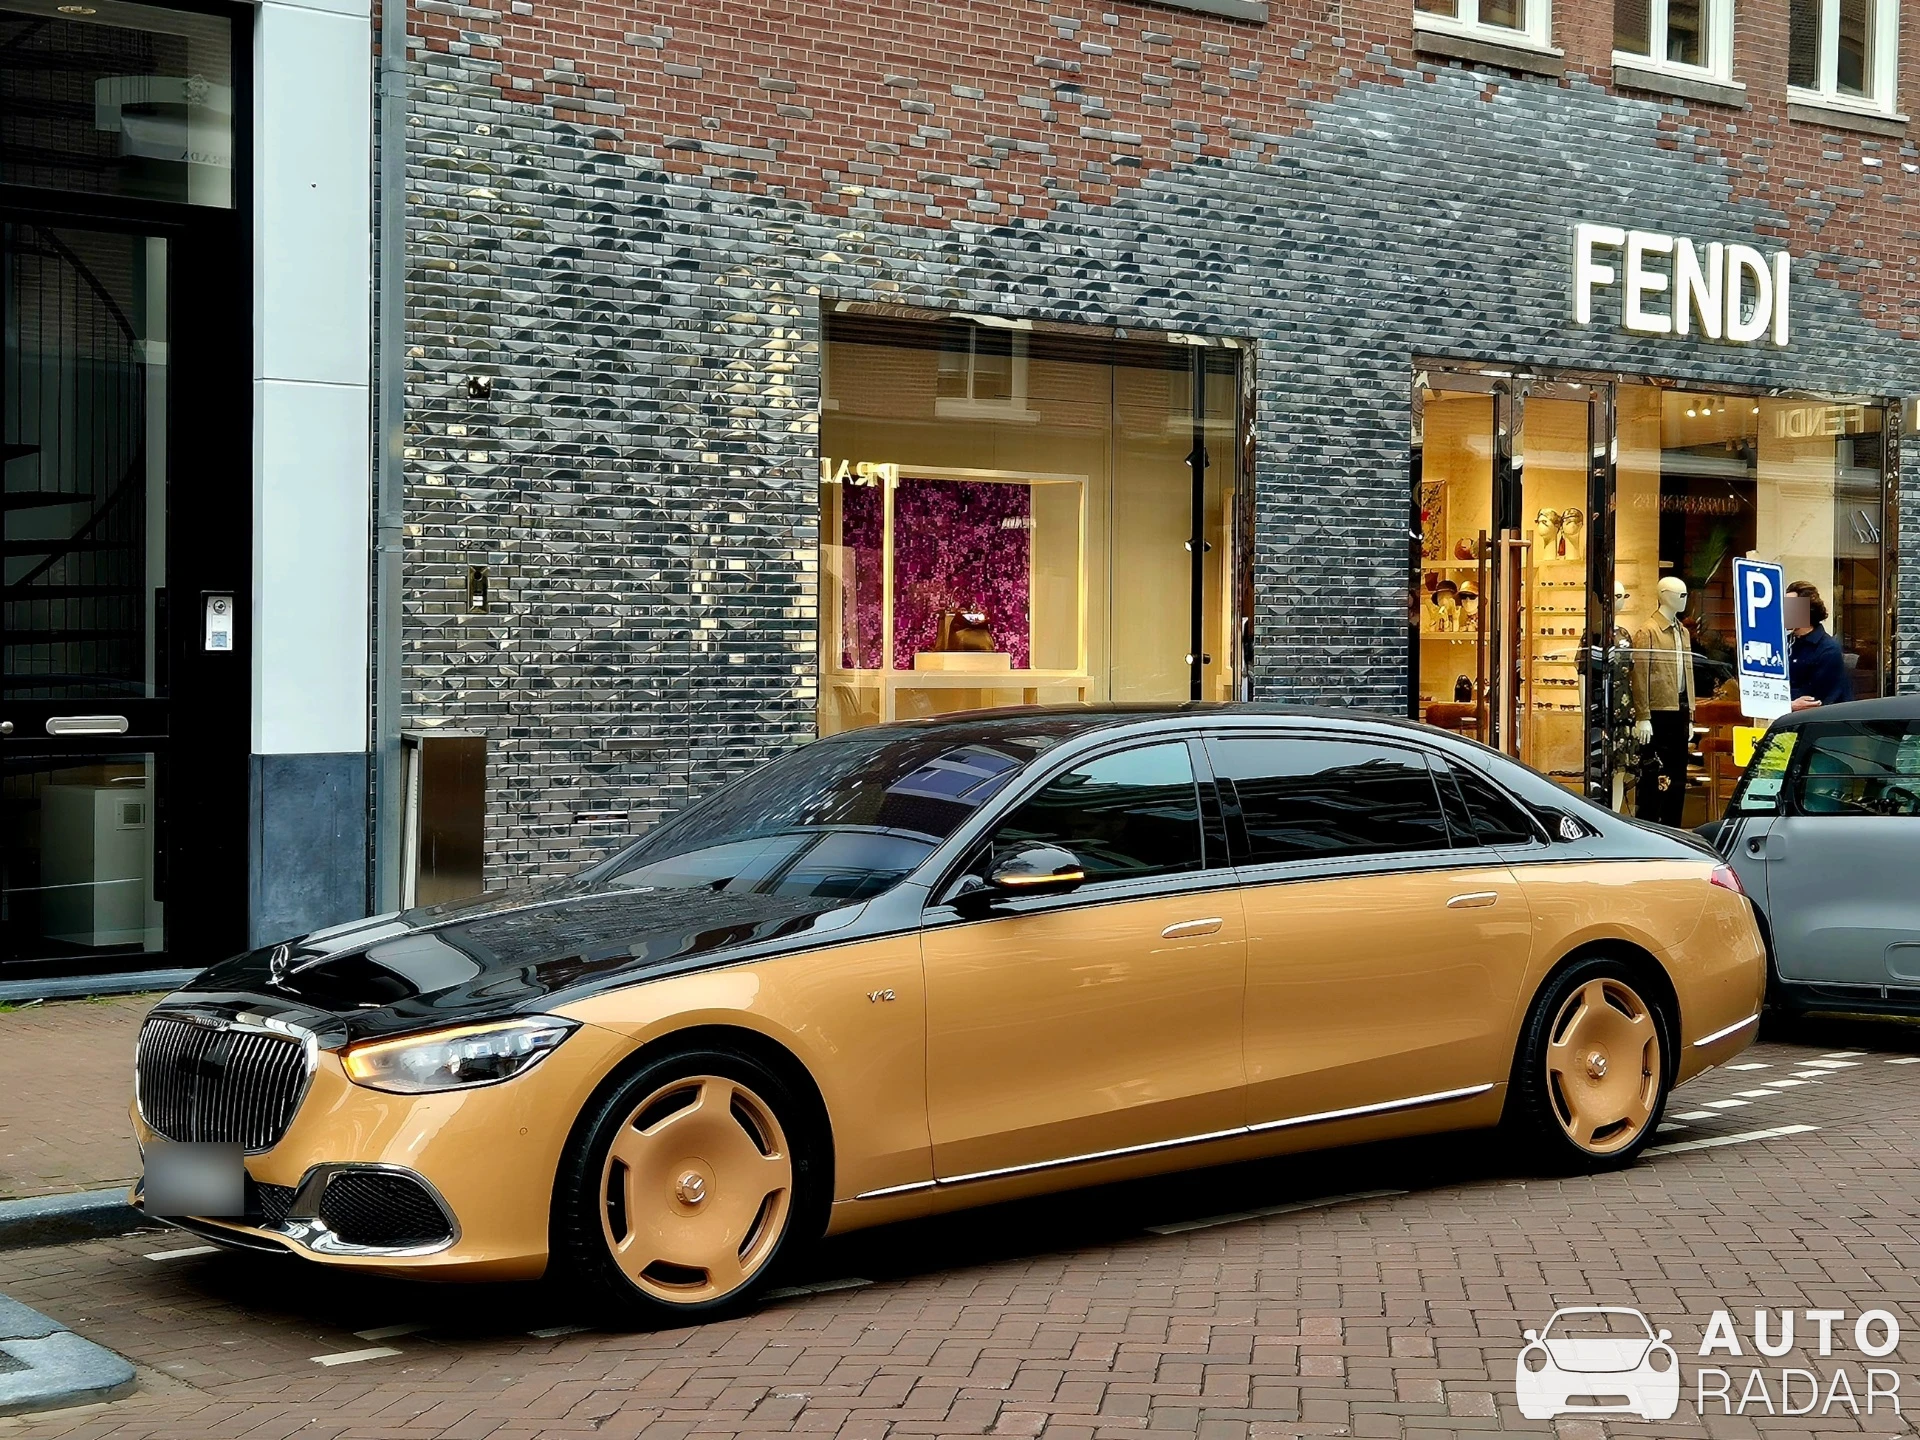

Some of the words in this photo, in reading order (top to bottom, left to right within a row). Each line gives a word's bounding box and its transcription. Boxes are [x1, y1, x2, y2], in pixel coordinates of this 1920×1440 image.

[1572, 223, 1790, 346] FENDI
[1746, 571, 1773, 628] P
[865, 987, 896, 1003] V12
